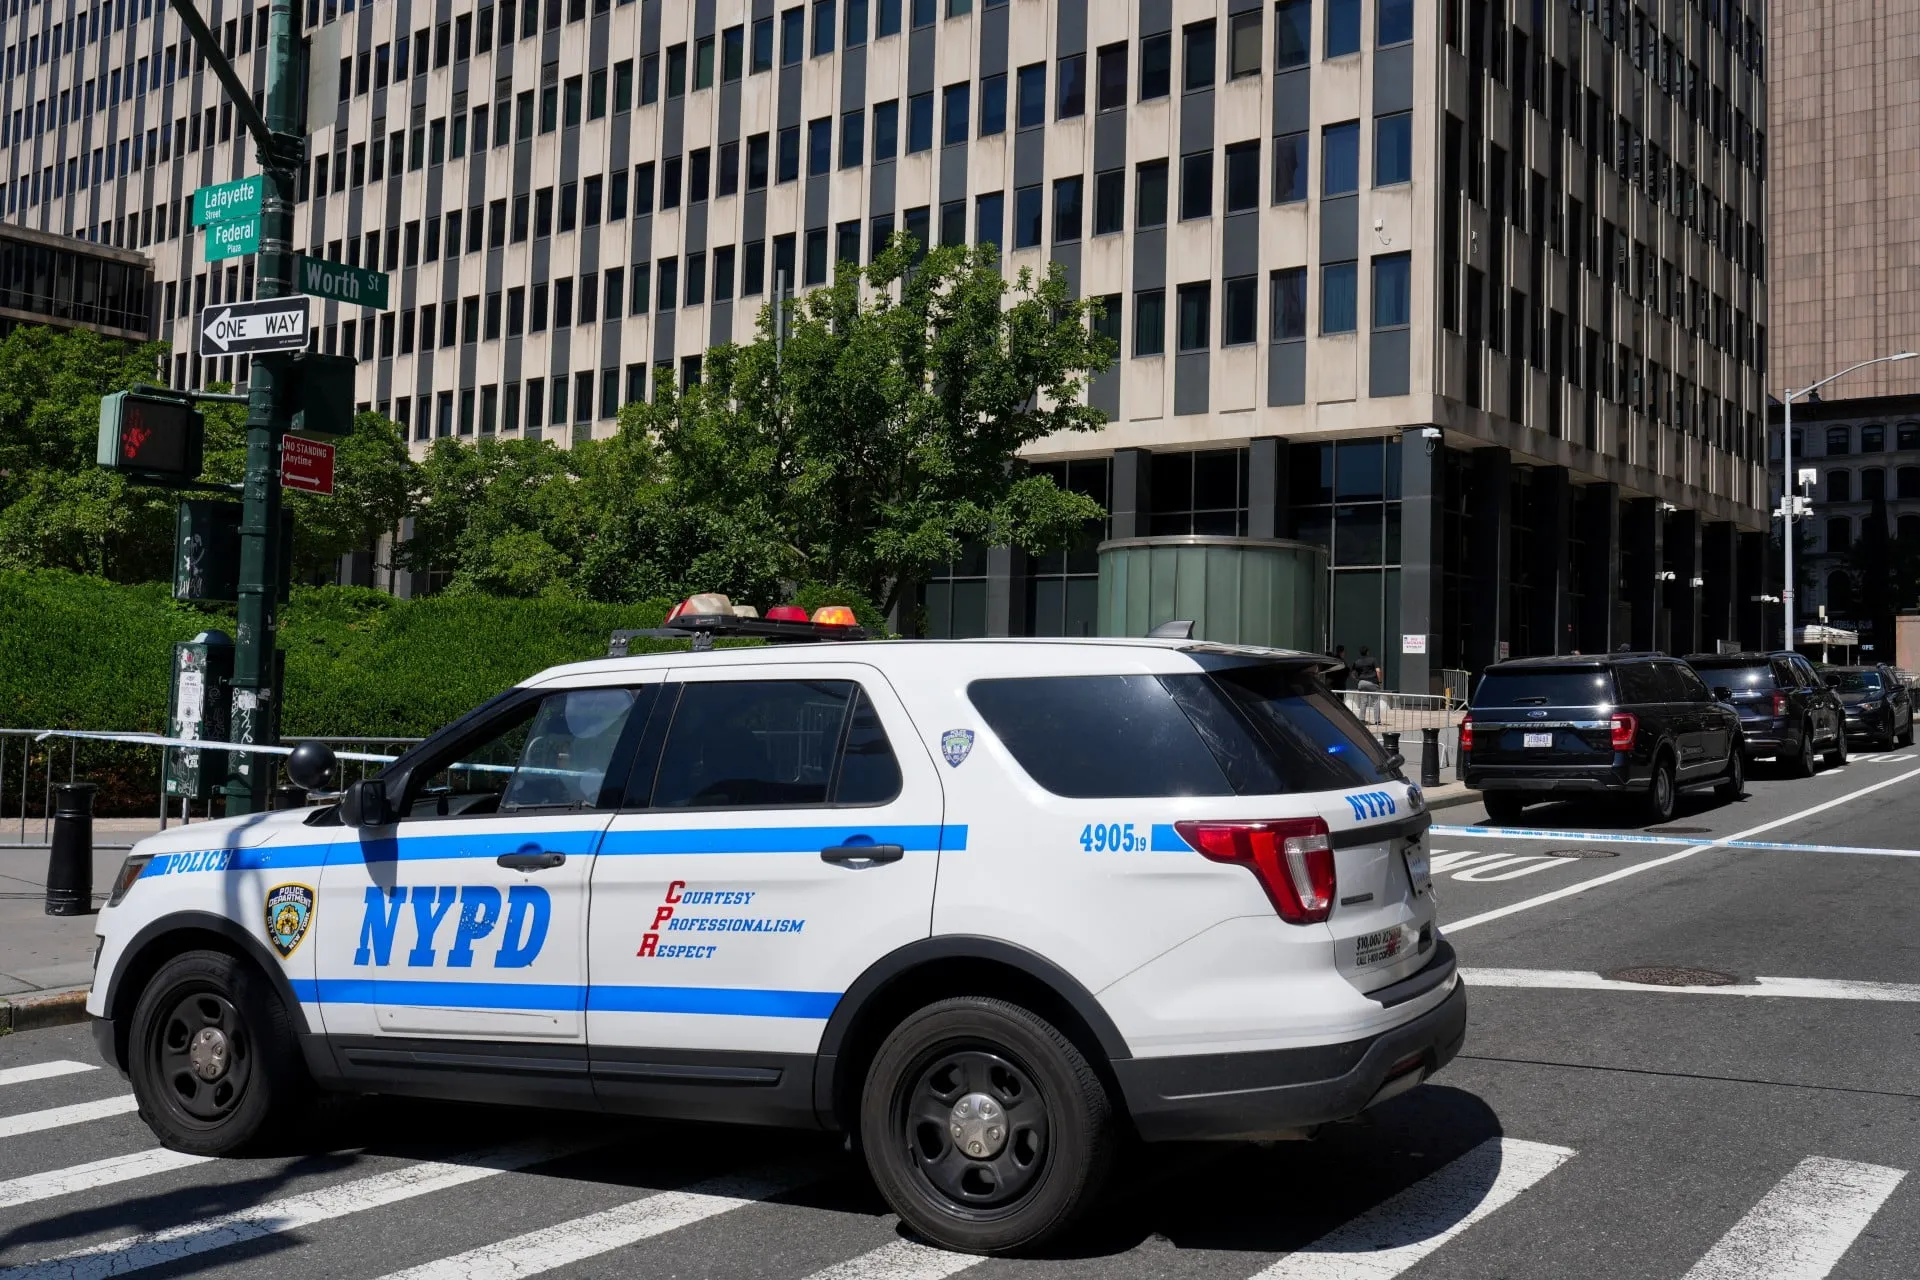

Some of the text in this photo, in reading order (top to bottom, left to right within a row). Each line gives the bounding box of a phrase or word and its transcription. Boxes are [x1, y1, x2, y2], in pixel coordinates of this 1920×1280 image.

[205, 182, 254, 209] Lafayette
[205, 208, 221, 220] Street
[215, 219, 254, 245] Federal
[227, 243, 242, 254] Plaza
[306, 262, 379, 299] Worth St
[215, 312, 300, 340] ONE WAY
[285, 440, 327, 459] NO STANDING
[285, 452, 312, 467] Anytime
[1344, 791, 1396, 821] NYPD
[166, 849, 230, 874] POLICE
[268, 894, 312, 908] DEPARTMENT
[279, 886, 305, 897] POLICE
[665, 880, 755, 905] COURTESY
[267, 915, 276, 934] CITY
[289, 911, 311, 950] NEW YORK
[353, 885, 551, 969] NYPD
[650, 906, 805, 933] PROFESSIONALISM
[637, 933, 717, 958] RESPECT
